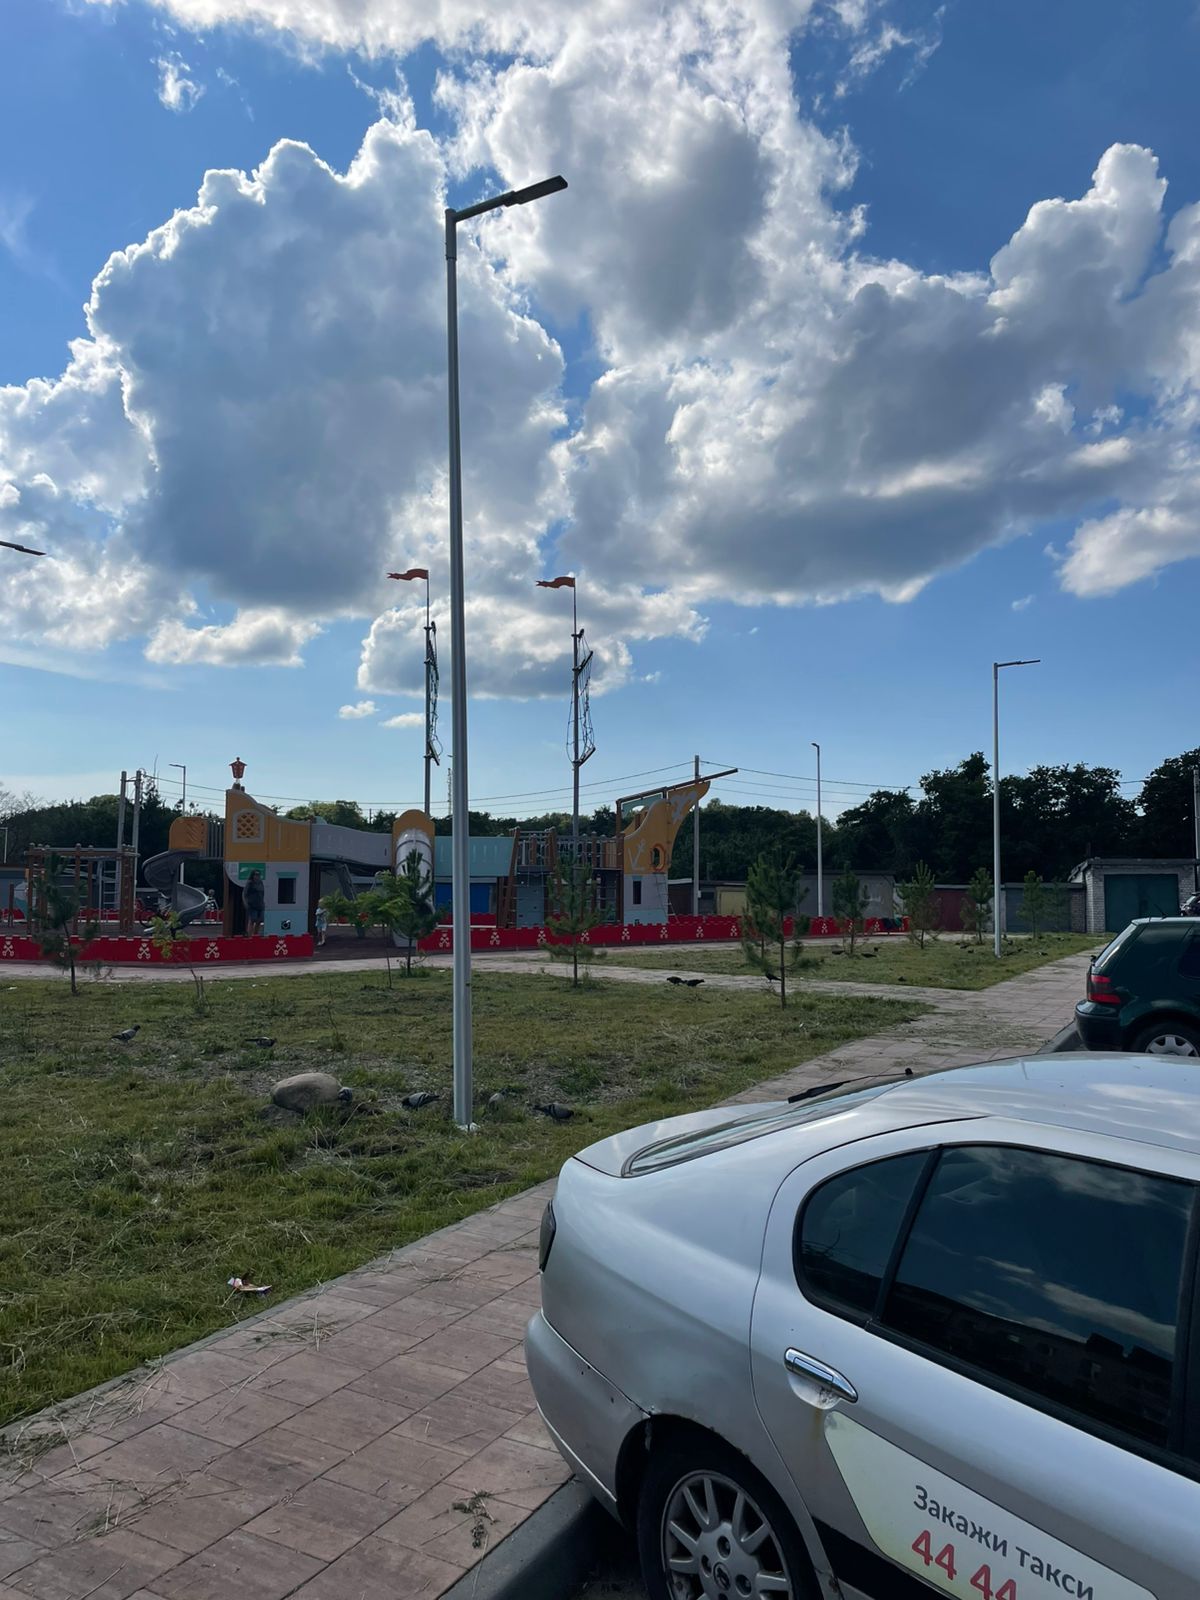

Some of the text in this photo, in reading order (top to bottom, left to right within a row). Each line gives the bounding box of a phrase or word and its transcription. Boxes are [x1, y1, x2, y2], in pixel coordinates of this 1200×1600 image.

[911, 1529, 957, 1581] 44
[913, 1484, 1094, 1600] Закажи такси
